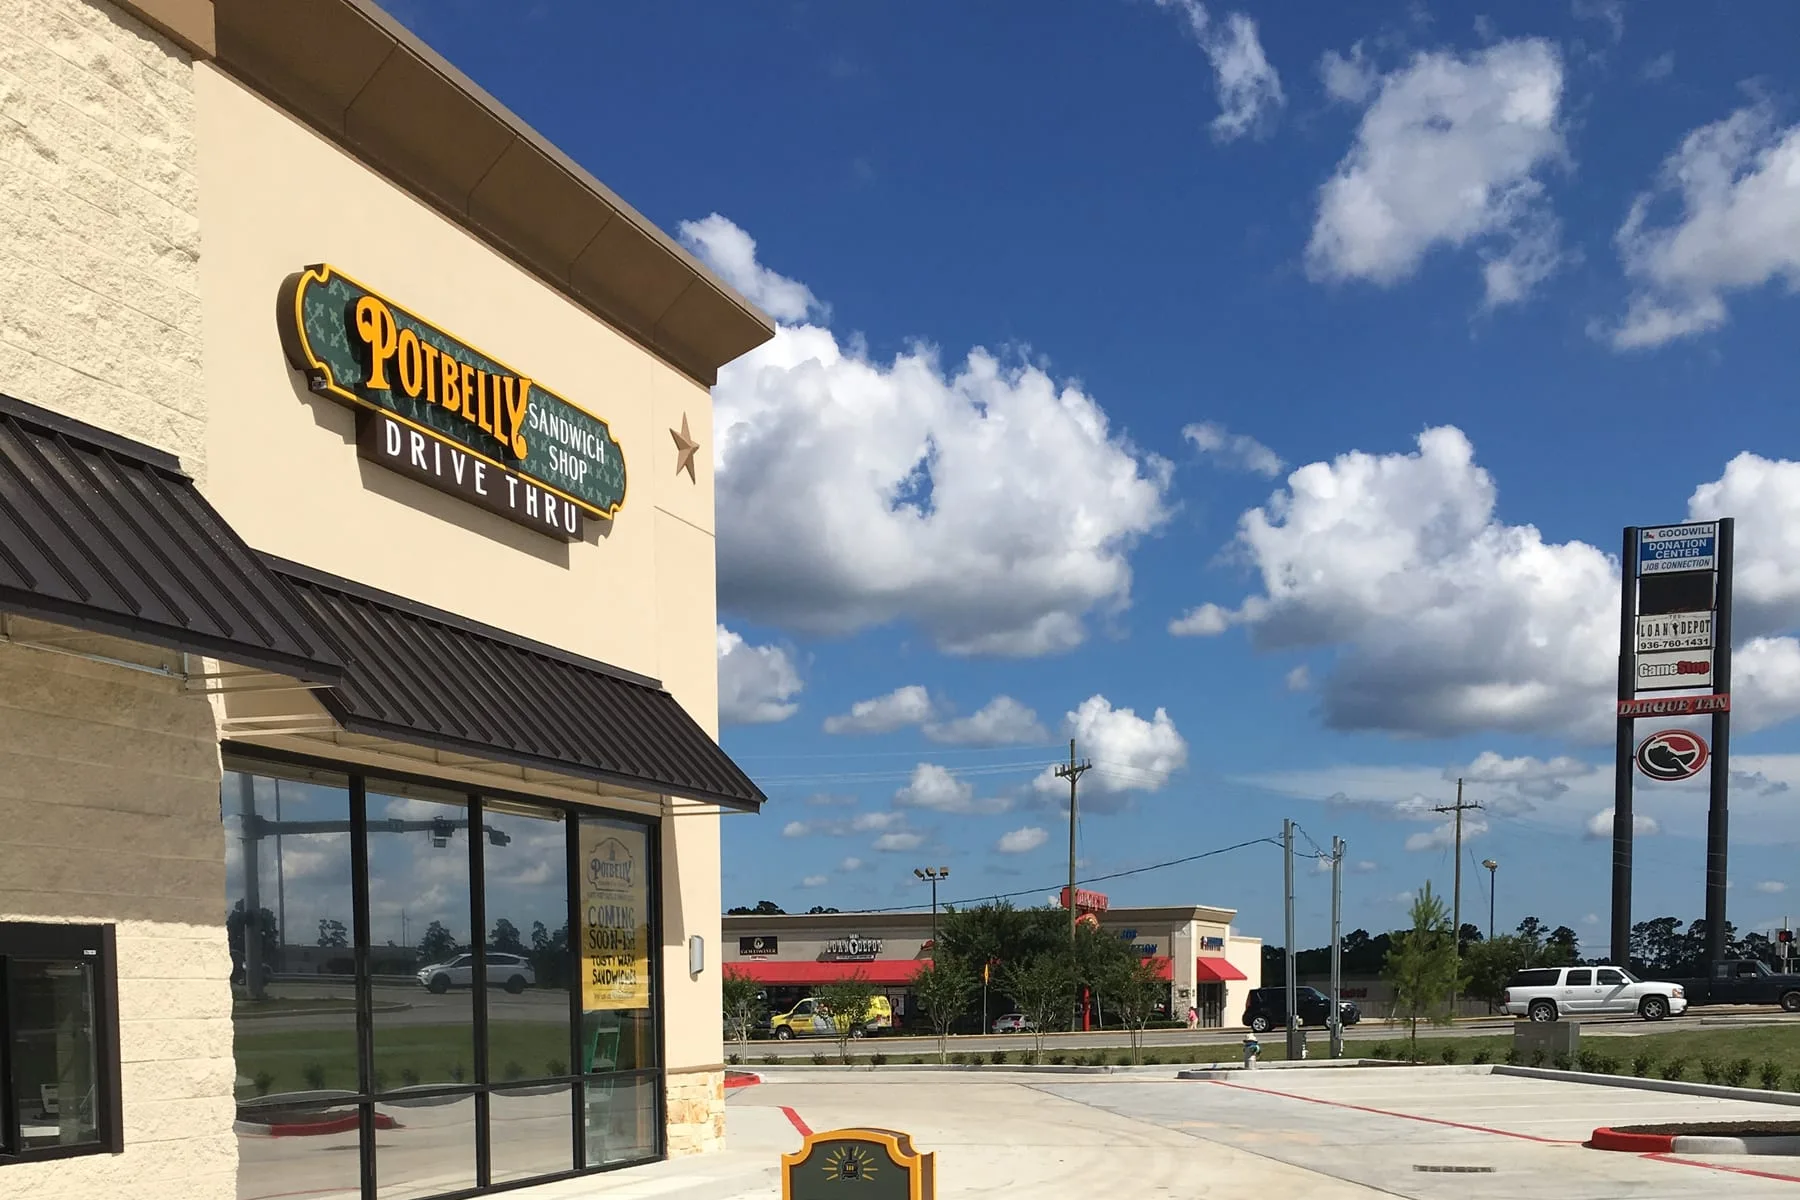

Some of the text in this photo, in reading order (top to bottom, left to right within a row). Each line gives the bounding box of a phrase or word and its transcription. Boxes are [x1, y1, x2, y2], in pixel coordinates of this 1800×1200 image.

[355, 296, 532, 460] POTBELLY
[528, 402, 605, 464] SANDWICH
[548, 445, 588, 485] SHOP
[385, 418, 578, 534] DRIVE THRU
[1658, 526, 1713, 538] GOODWILL
[1648, 538, 1707, 551] DONATION
[1655, 548, 1700, 559] CENTER
[1644, 558, 1710, 571] JOB CONNECTION
[1640, 620, 1710, 637] LOAN DEPOT
[1640, 638, 1708, 649] 936-760-1431
[1639, 660, 1710, 677] GameStop
[1619, 696, 1728, 715] DARQUE TAN
[588, 905, 635, 929] COMING
[826, 939, 883, 953] LOAN DEPOT
